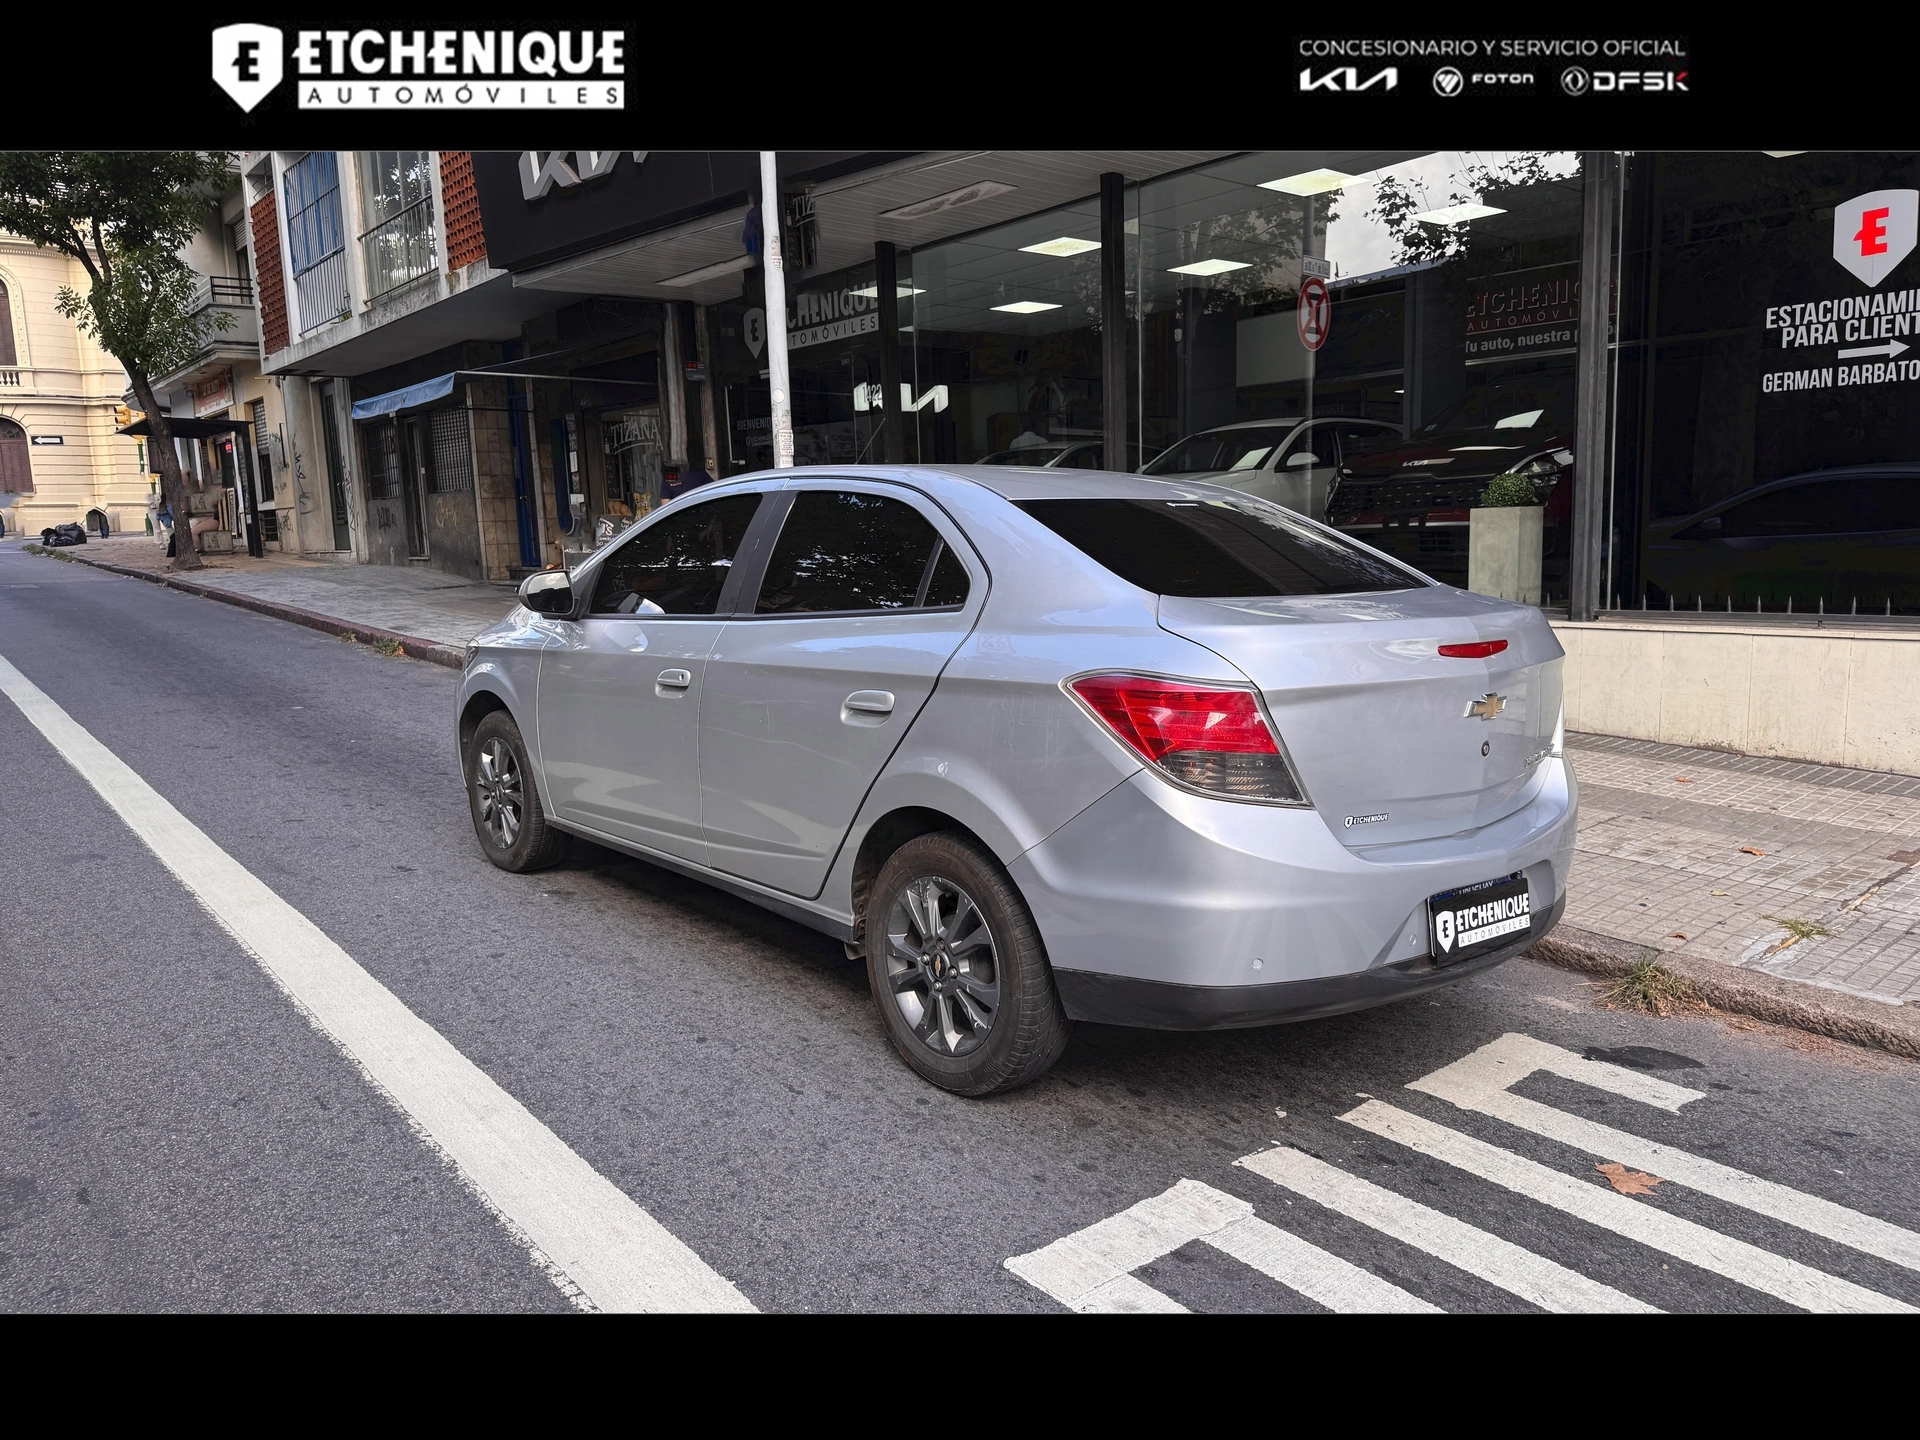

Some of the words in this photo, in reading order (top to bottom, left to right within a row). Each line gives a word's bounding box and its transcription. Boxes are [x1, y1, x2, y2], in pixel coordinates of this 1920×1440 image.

[786, 280, 878, 329] CHENIQUE
[1467, 308, 1573, 331] AUTOMÓVI
[792, 315, 877, 346] TOMÓVILES
[1481, 335, 1515, 351] auto,
[1518, 329, 1571, 347] nuestra
[1782, 322, 1839, 349] PARA
[1763, 367, 1833, 393] GERMAN
[1837, 359, 1920, 387] BARBATO
[611, 417, 660, 449] TIZANA
[737, 416, 772, 431] BIENVENID
[1456, 893, 1530, 932] ETCHENIQUE
